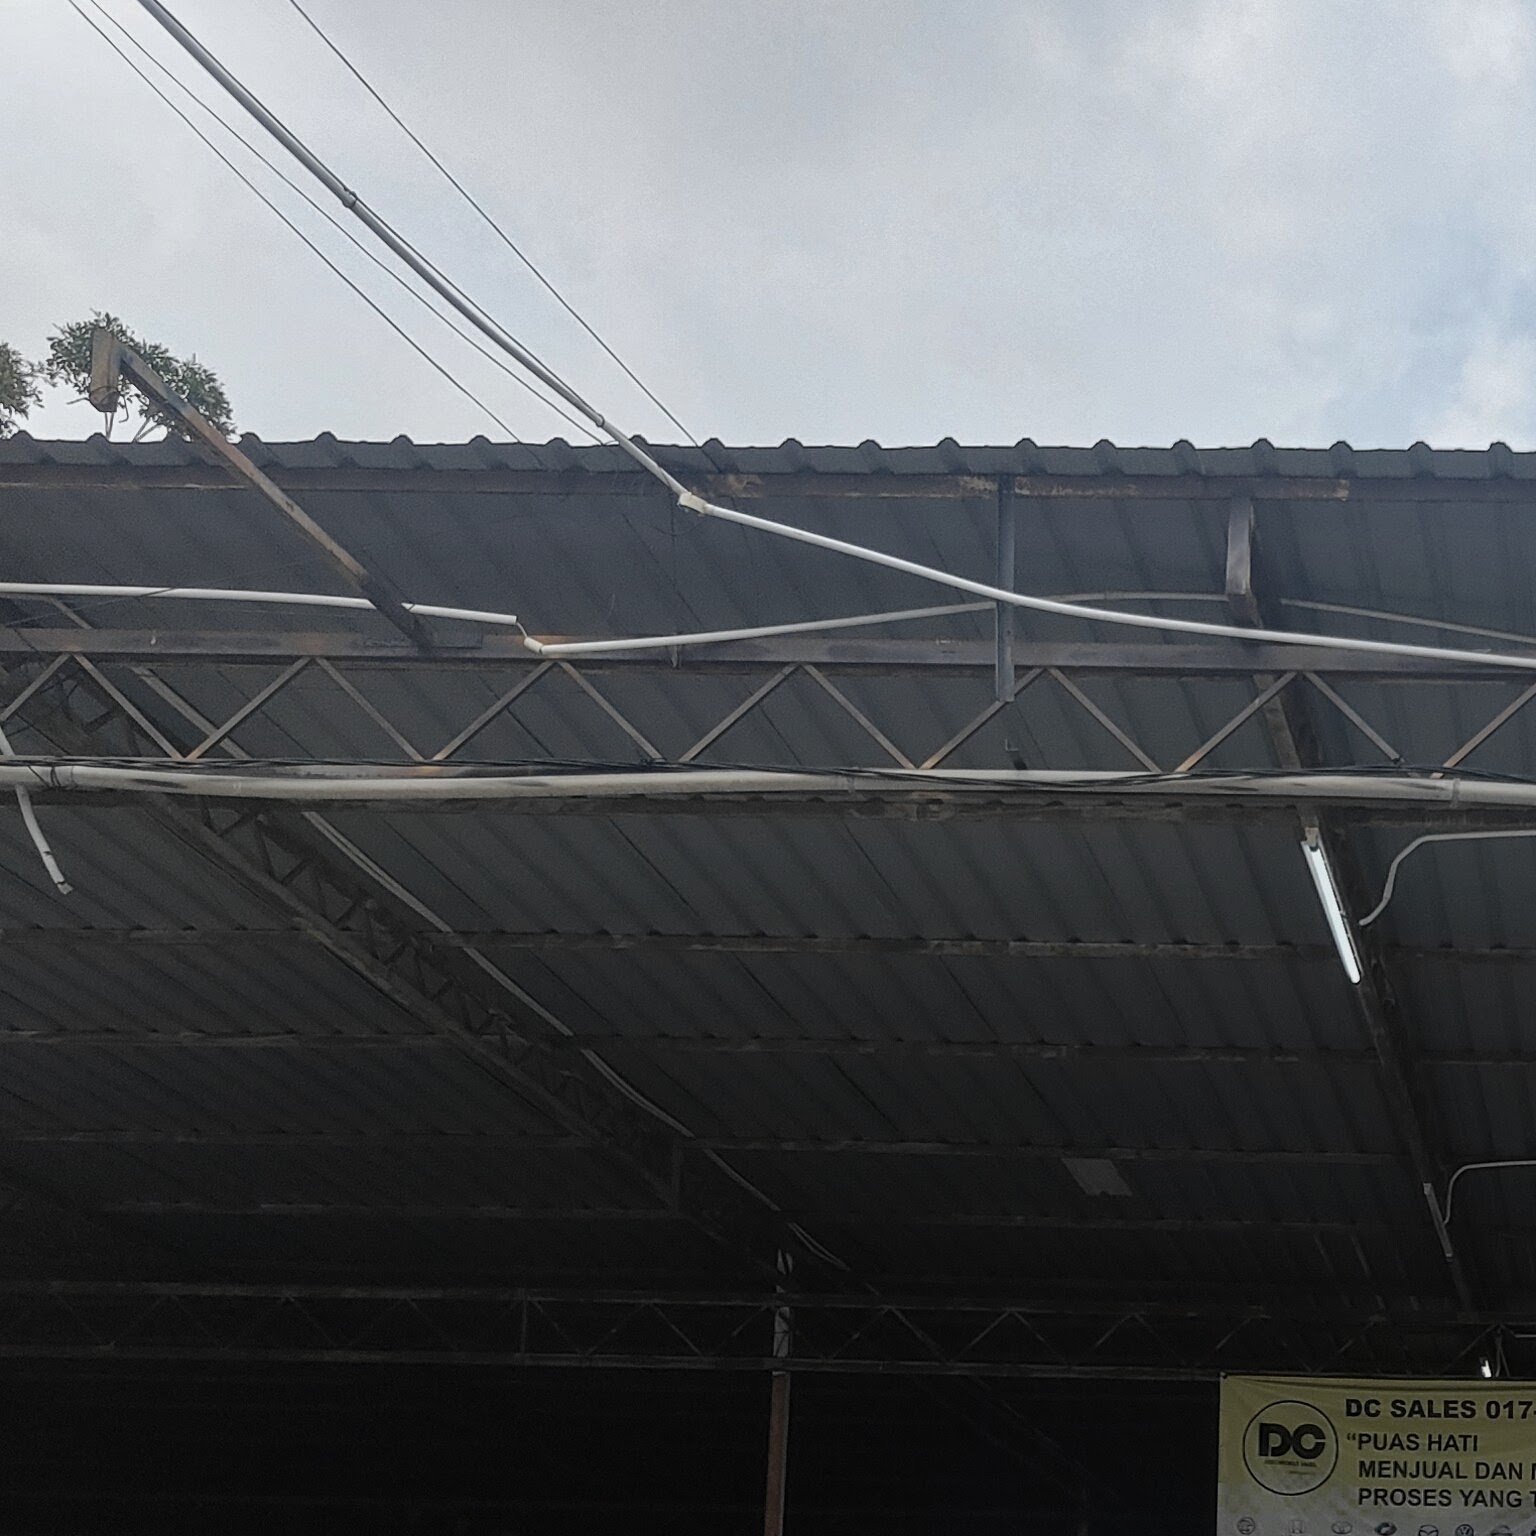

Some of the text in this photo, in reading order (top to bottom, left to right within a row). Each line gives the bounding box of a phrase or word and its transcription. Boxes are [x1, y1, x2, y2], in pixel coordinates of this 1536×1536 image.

[1345, 1398, 1381, 1418] DC
[1390, 1399, 1476, 1418] SALES
[1259, 1423, 1326, 1459] DC
[1428, 1434, 1478, 1452] HATI
[1358, 1460, 1468, 1479] MENJUAL
[1475, 1462, 1523, 1480] DAN
[1358, 1488, 1452, 1507] PROSES
[1459, 1489, 1522, 1508] YANG
